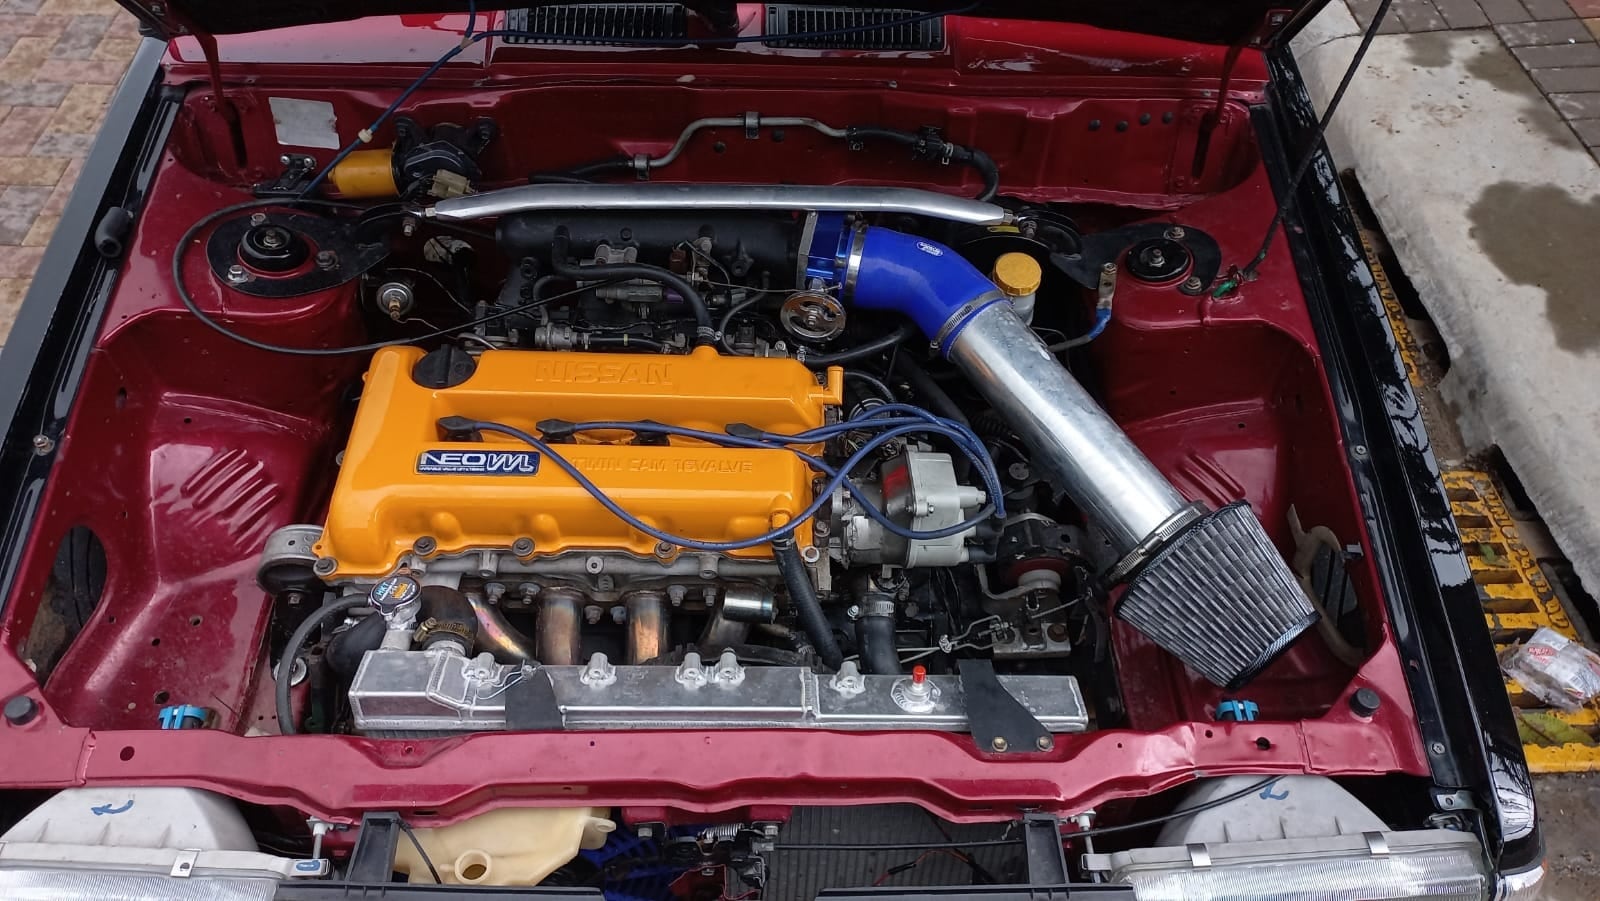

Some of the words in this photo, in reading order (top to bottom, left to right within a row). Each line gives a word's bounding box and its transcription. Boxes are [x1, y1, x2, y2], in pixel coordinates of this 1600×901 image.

[535, 360, 673, 386] NISSAN
[572, 456, 623, 472] TWIN
[629, 457, 668, 473] CAM
